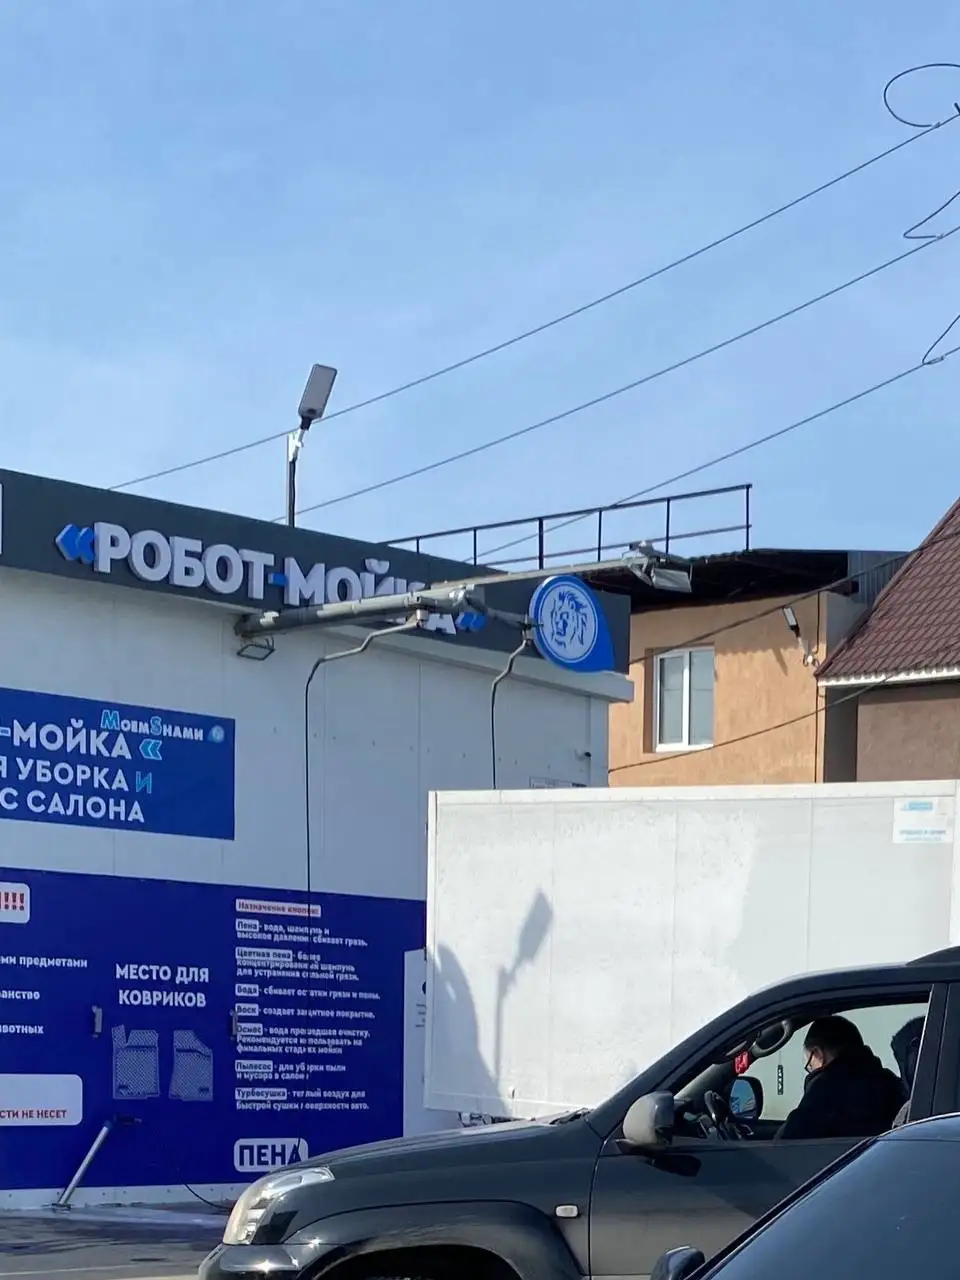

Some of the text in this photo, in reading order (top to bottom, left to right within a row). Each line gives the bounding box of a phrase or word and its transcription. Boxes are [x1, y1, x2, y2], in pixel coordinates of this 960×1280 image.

[16, 757, 129, 792] УБОРКА
[136, 771, 152, 794] И
[0, 787, 145, 823] С САЛОНА
[237, 920, 257, 930] Пена
[237, 949, 271, 958] Цветная
[19, 956, 88, 968] предметами
[115, 963, 210, 984] МЕСТО ДЛЯ
[237, 968, 252, 976] для
[0, 989, 40, 1000] анство
[237, 985, 257, 994] Вода
[118, 989, 207, 1008] КОВРИКОВ
[237, 1005, 257, 1013] Воск
[269, 1027, 289, 1035] вода
[236, 1061, 272, 1070] Пылесос
[278, 1063, 294, 1072] для
[244, 1072, 273, 1081] мусора
[236, 1088, 286, 1098] Турбосушка
[323, 1091, 350, 1099] воздух
[351, 1090, 366, 1099] для
[273, 1103, 299, 1111] сушки
[21, 1109, 34, 1119] НЕ
[36, 1109, 67, 1119] НЕСЕТ
[239, 1144, 302, 1167] ПЕНА
